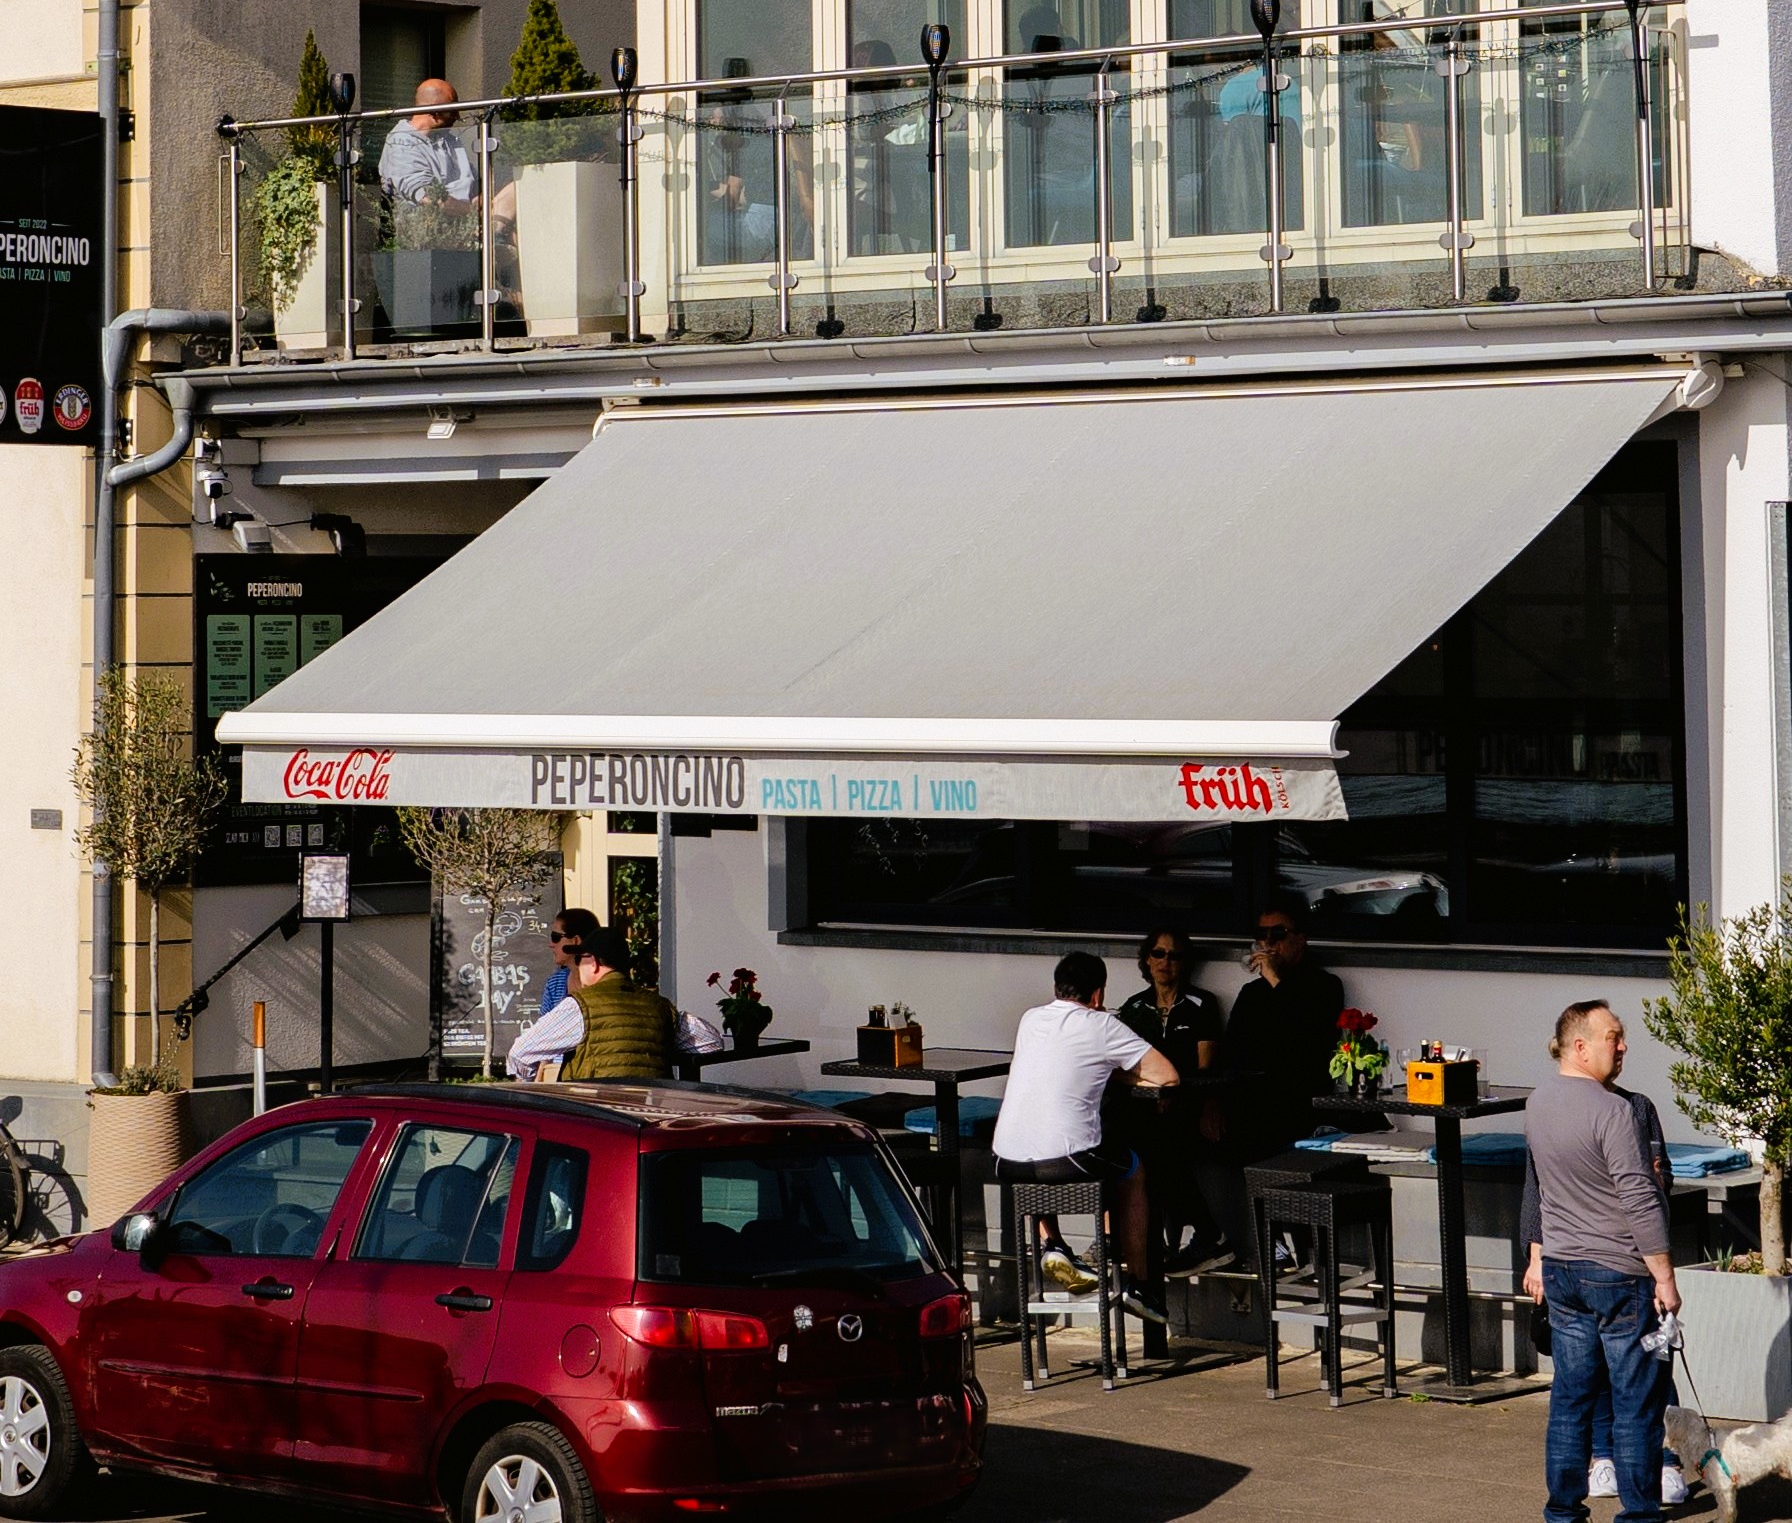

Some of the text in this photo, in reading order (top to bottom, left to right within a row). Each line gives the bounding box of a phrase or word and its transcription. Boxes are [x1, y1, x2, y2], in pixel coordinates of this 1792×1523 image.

[18, 218, 31, 228] SEIT
[24, 268, 45, 281] PIZZA
[53, 270, 71, 283] VINO
[55, 387, 89, 406] ERDINGER
[20, 401, 40, 417] früh
[247, 582, 303, 598] PEPERONCINO
[283, 747, 397, 801] Coca-Cola
[530, 753, 746, 809] PEPERONCINO
[762, 778, 978, 813] PASTA PIZZA VINO
[1178, 761, 1290, 815] früh KÖLSCH
[231, 805, 282, 817] EVENTLOCATION
[458, 963, 531, 987] GABAS
[716, 1405, 759, 1417] mazda
